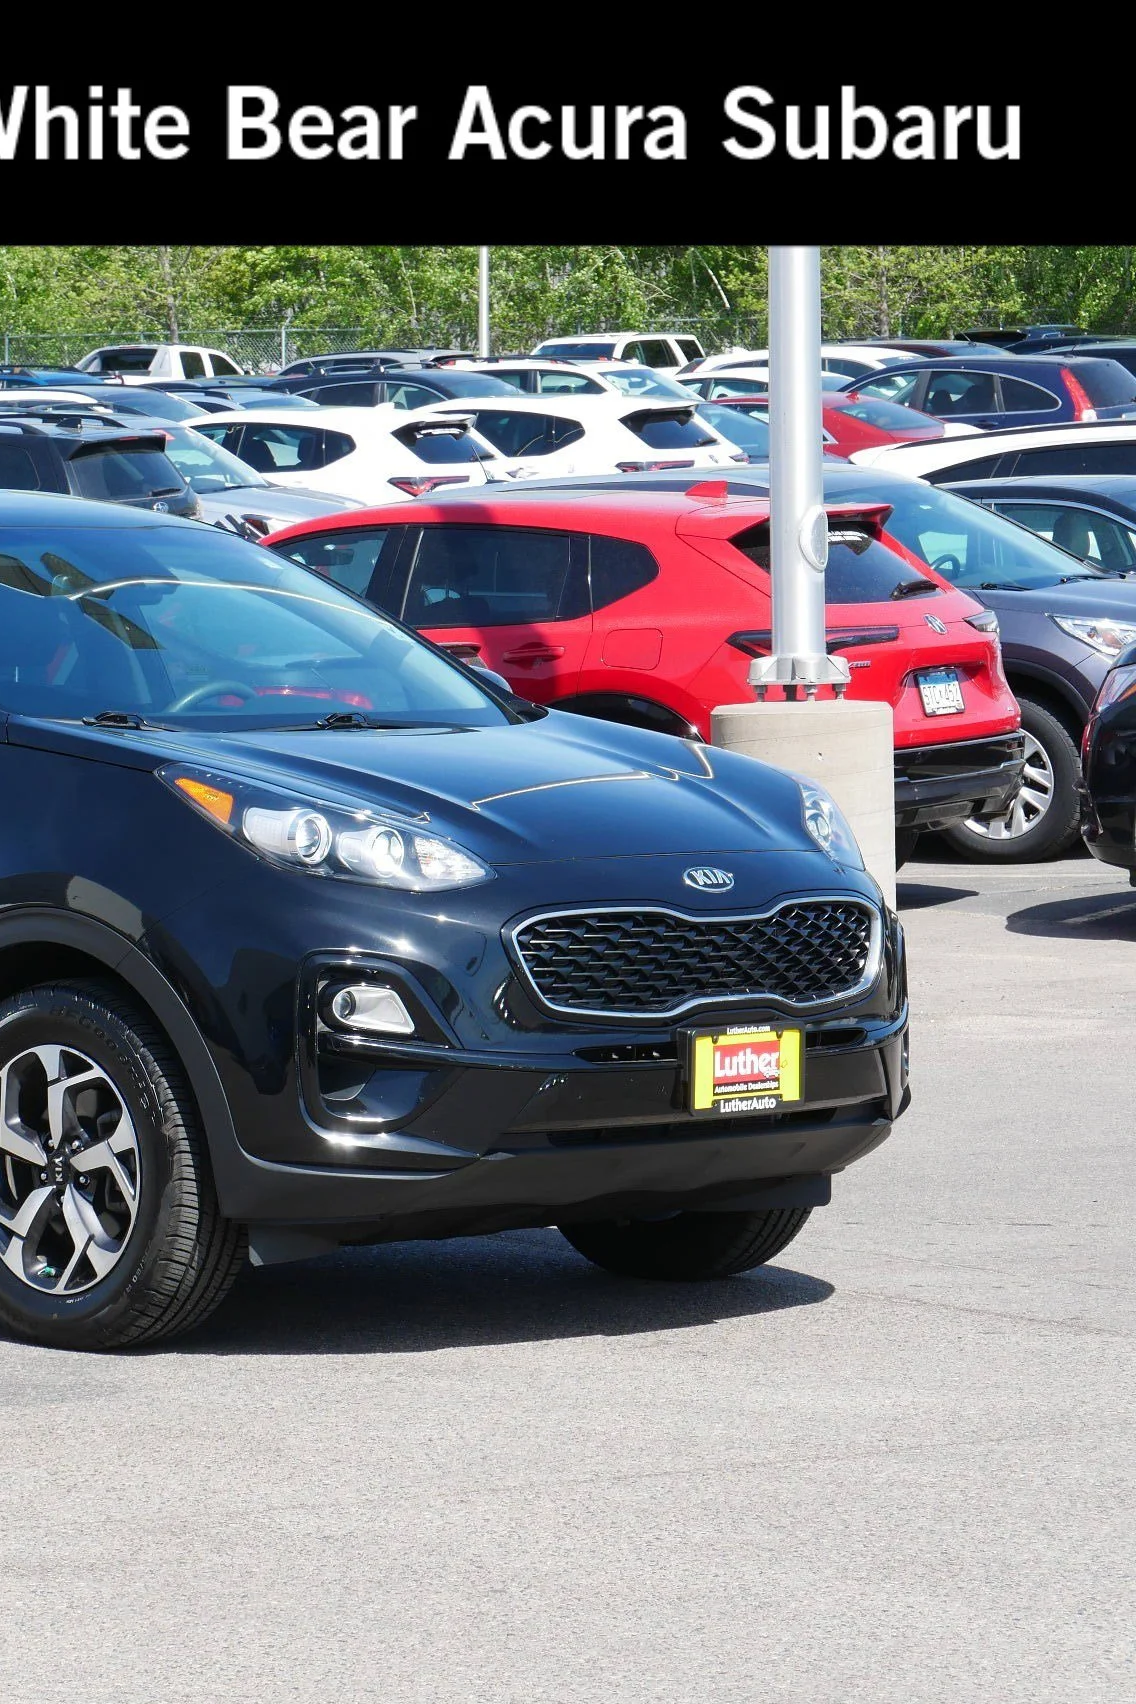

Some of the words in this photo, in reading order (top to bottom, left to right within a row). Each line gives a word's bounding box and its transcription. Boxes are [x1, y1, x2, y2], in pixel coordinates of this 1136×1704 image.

[690, 869, 730, 885] KIA
[714, 1047, 780, 1077] Luther
[720, 1097, 777, 1113] LutherAuto
[54, 1156, 63, 1182] KIA
